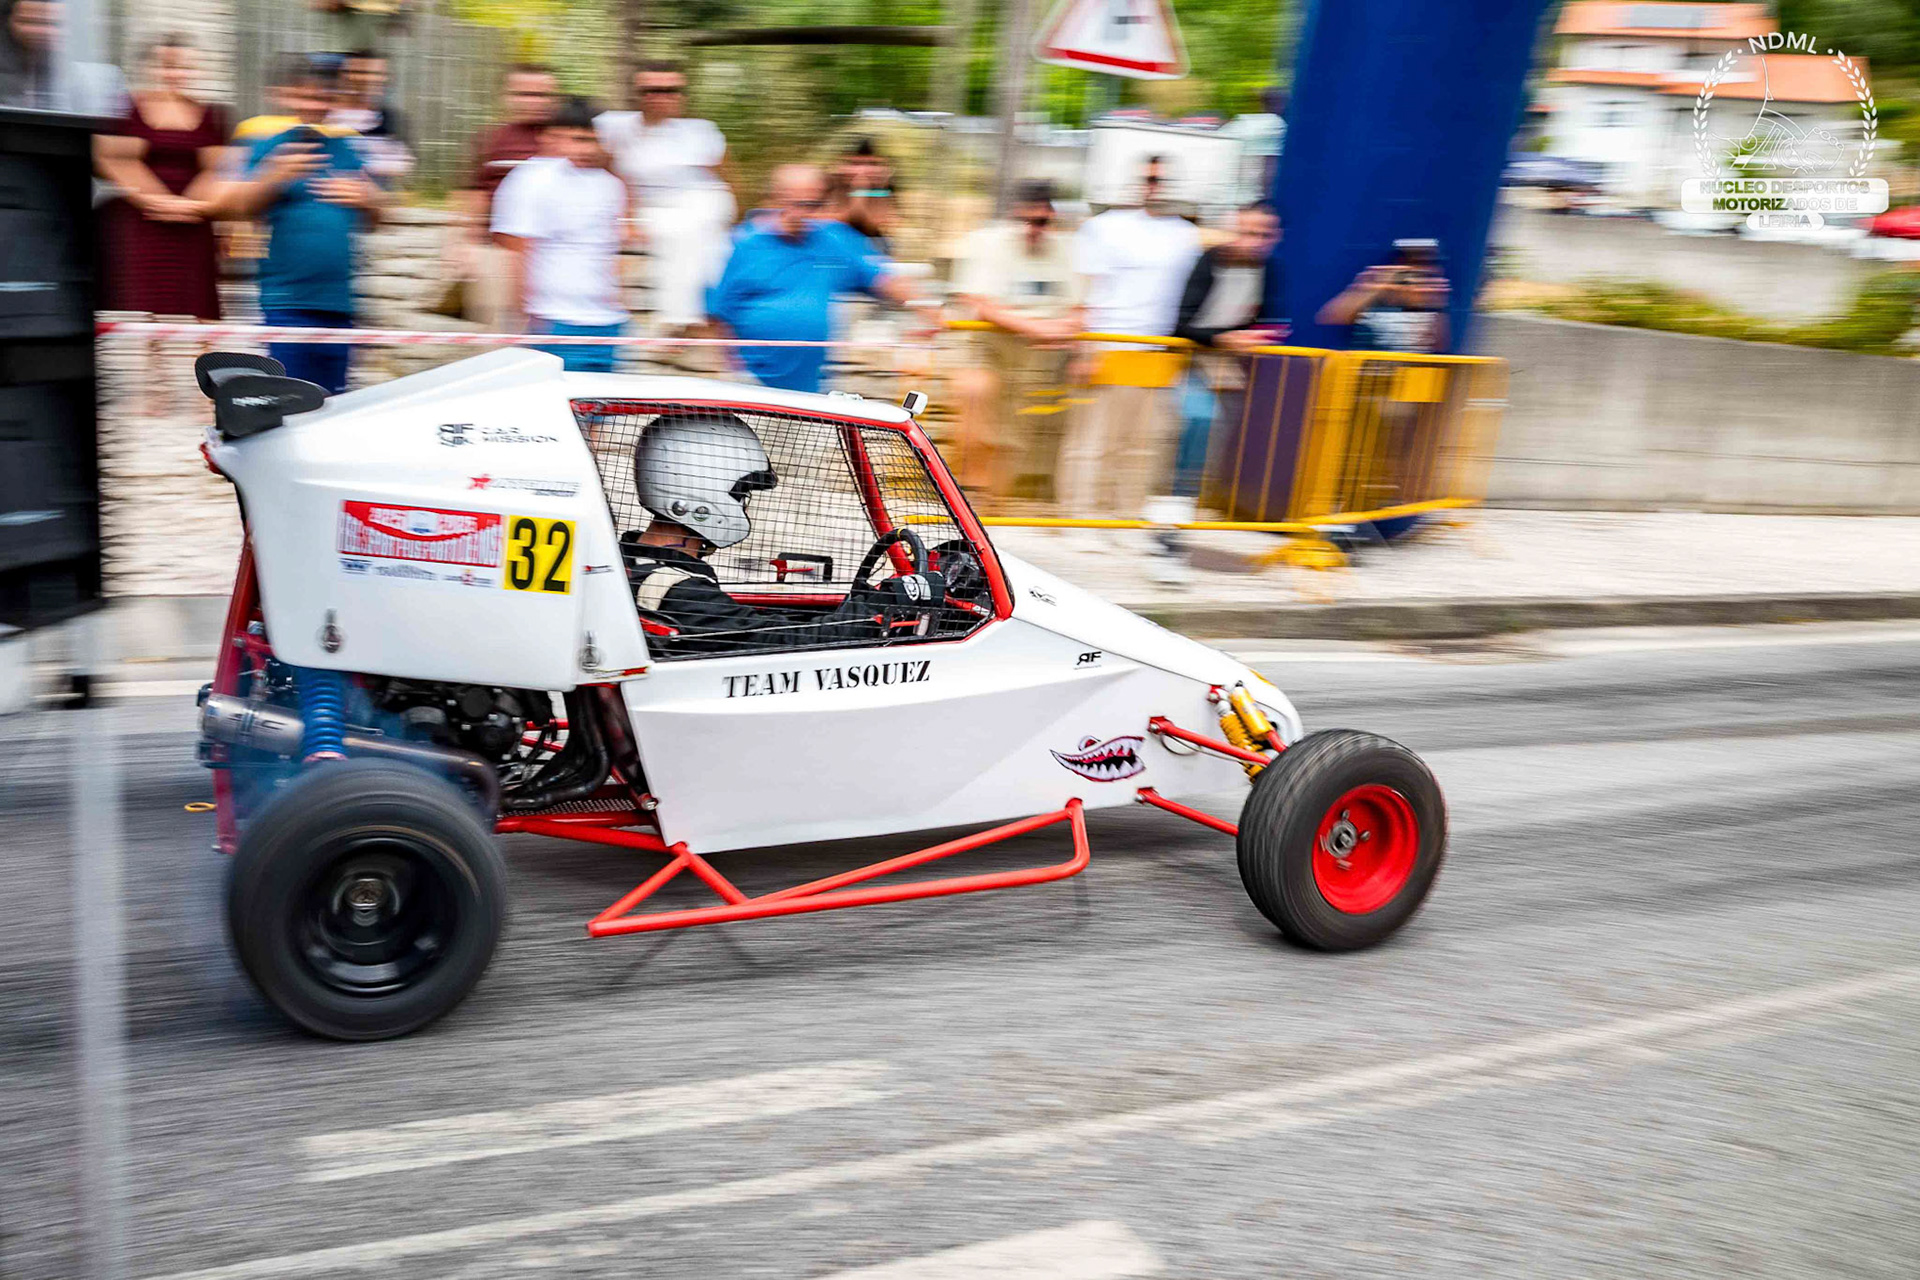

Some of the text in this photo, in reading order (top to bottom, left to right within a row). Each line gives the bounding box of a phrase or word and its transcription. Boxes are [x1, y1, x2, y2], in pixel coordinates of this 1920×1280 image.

[510, 517, 571, 592] 32
[722, 660, 931, 699] TEAM VASQUEZ
